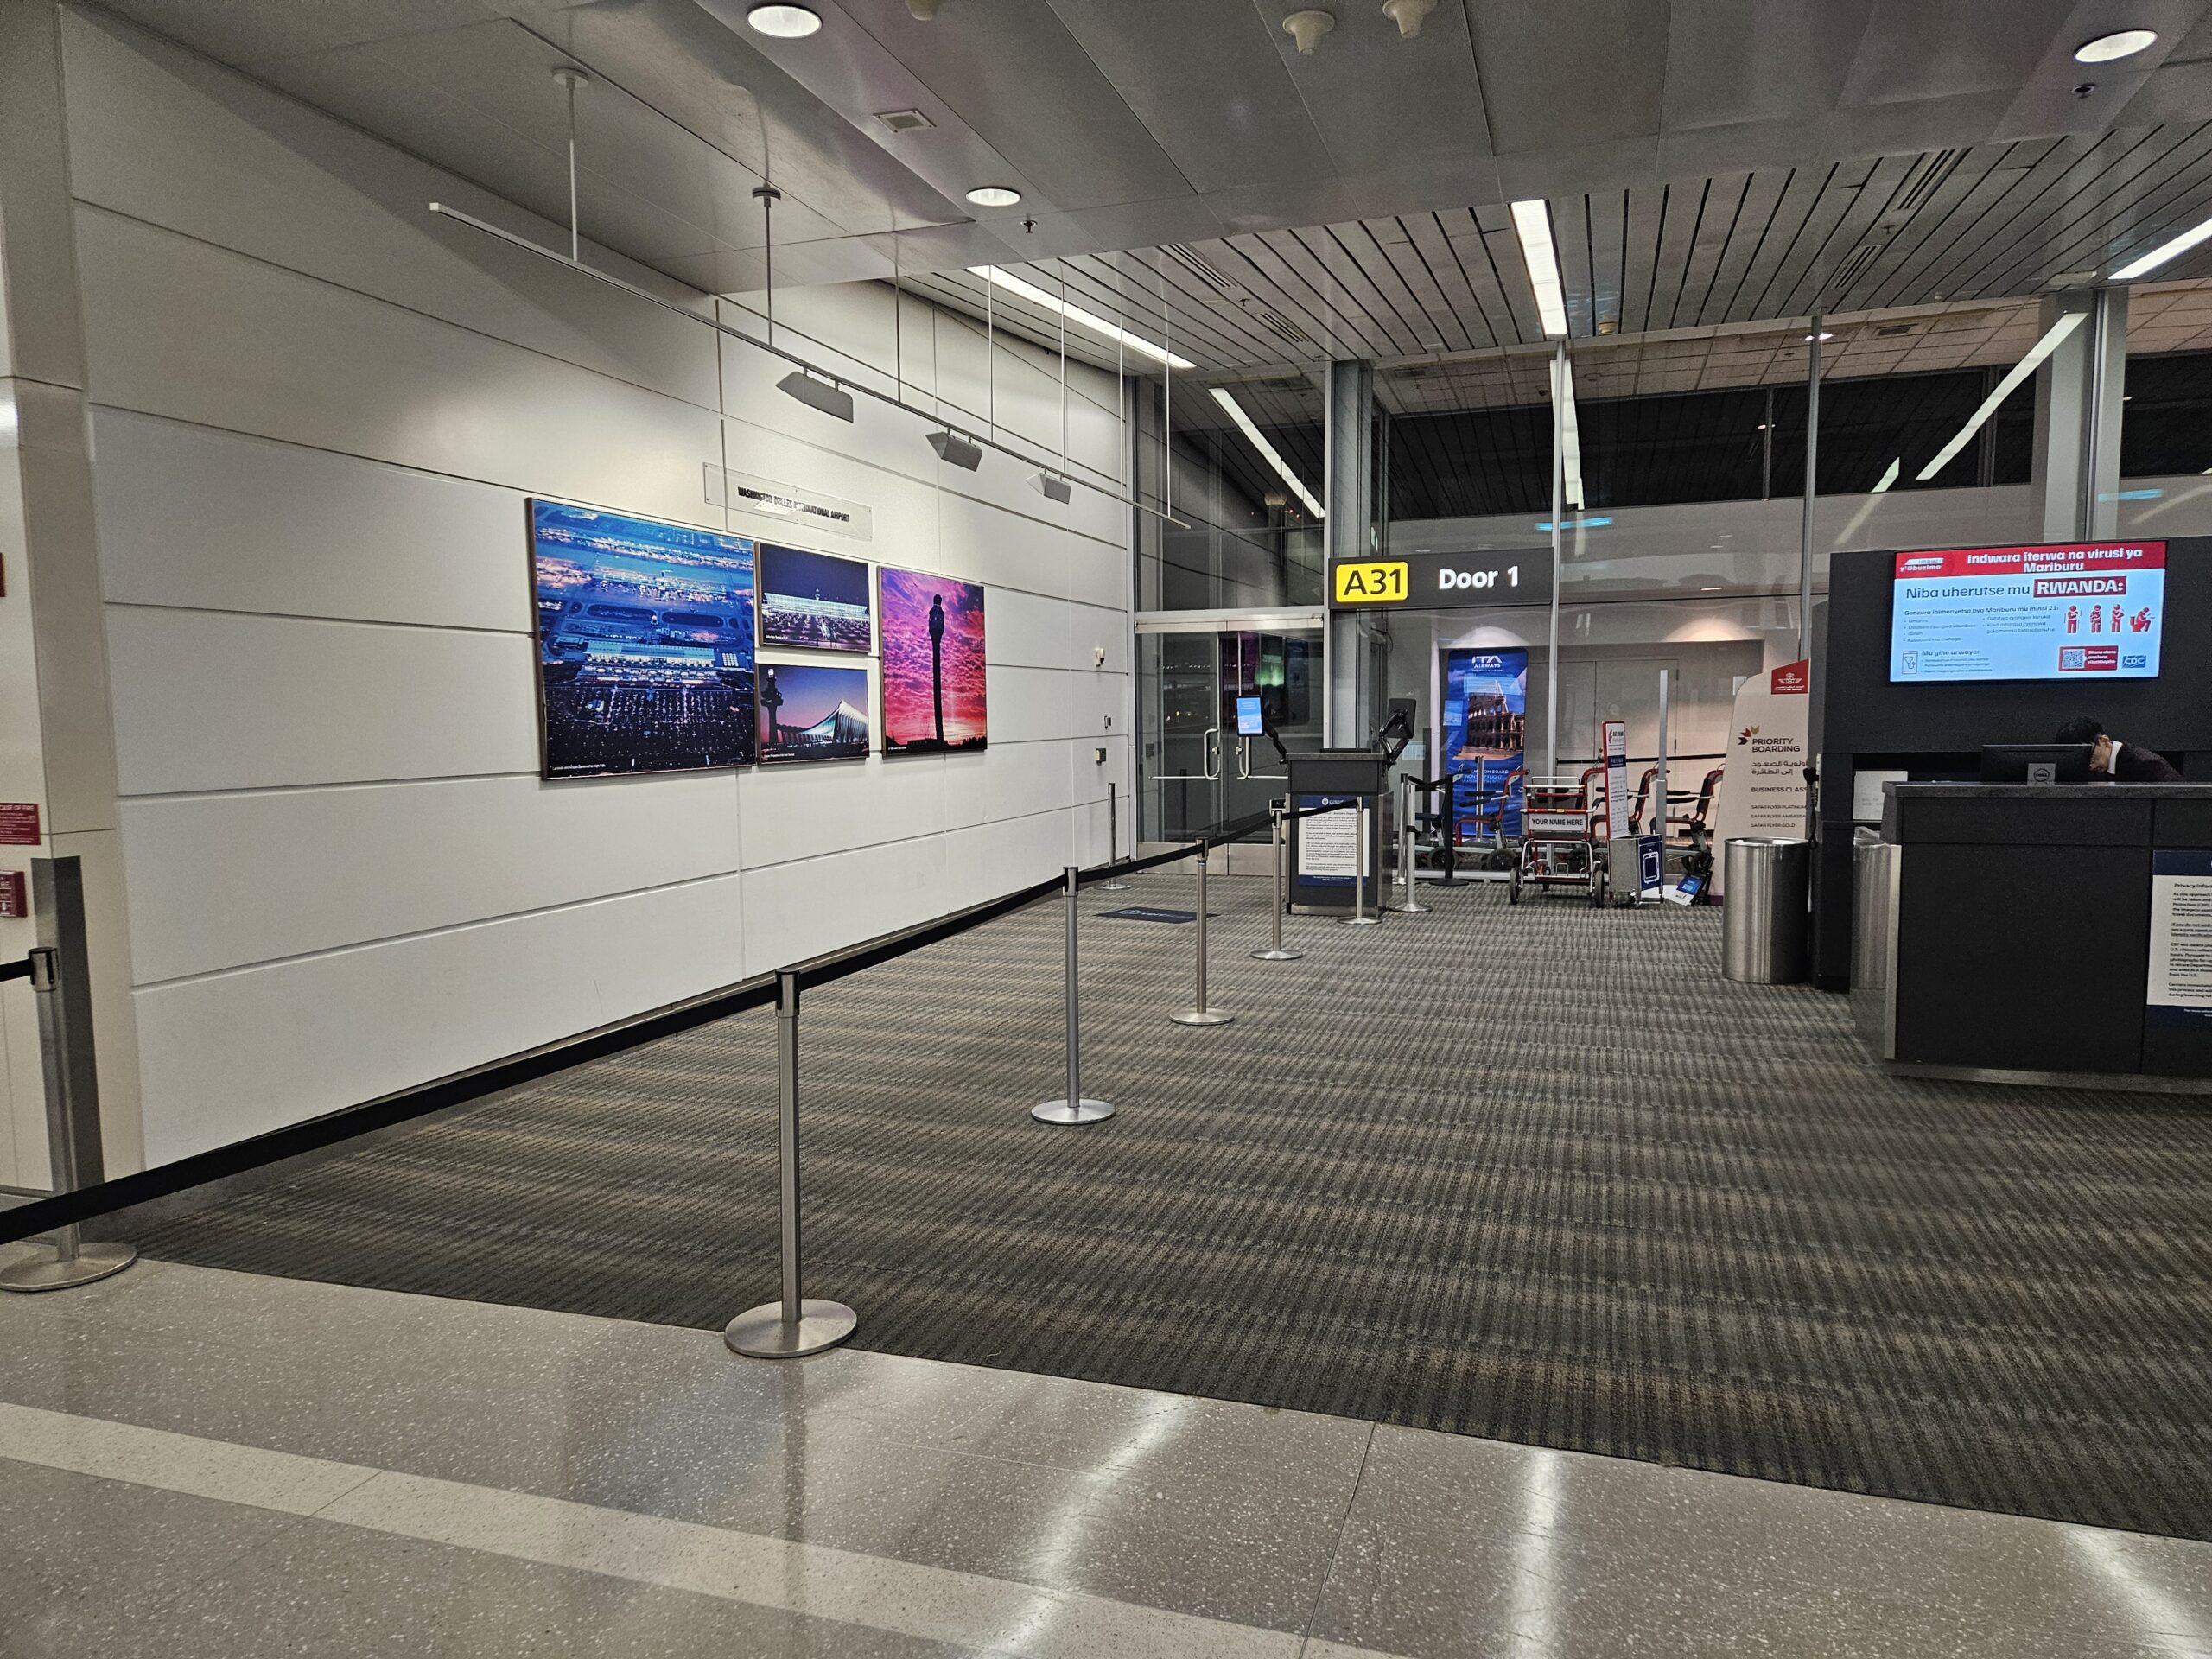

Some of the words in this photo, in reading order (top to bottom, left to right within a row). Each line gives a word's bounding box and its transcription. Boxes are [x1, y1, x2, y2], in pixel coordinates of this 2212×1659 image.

[737, 486, 773, 503] WASHINGTON
[774, 496, 792, 509] DULLES
[830, 510, 849, 522] AIRPORT
[1967, 553, 2021, 564] Indwara
[2023, 551, 2065, 562] iterwa
[2087, 548, 2124, 559] virusi
[2126, 549, 2143, 559] ya
[2023, 562, 2085, 573] Mariburu
[1344, 568, 1401, 596] A31
[1439, 568, 1498, 590] Door
[1506, 566, 1519, 587] 1
[1906, 588, 1939, 599] Niba
[1942, 586, 2005, 598] uherutse
[2008, 586, 2030, 595] mu
[2037, 579, 2124, 595] RWANDA:
[1472, 655, 1502, 663] ITA
